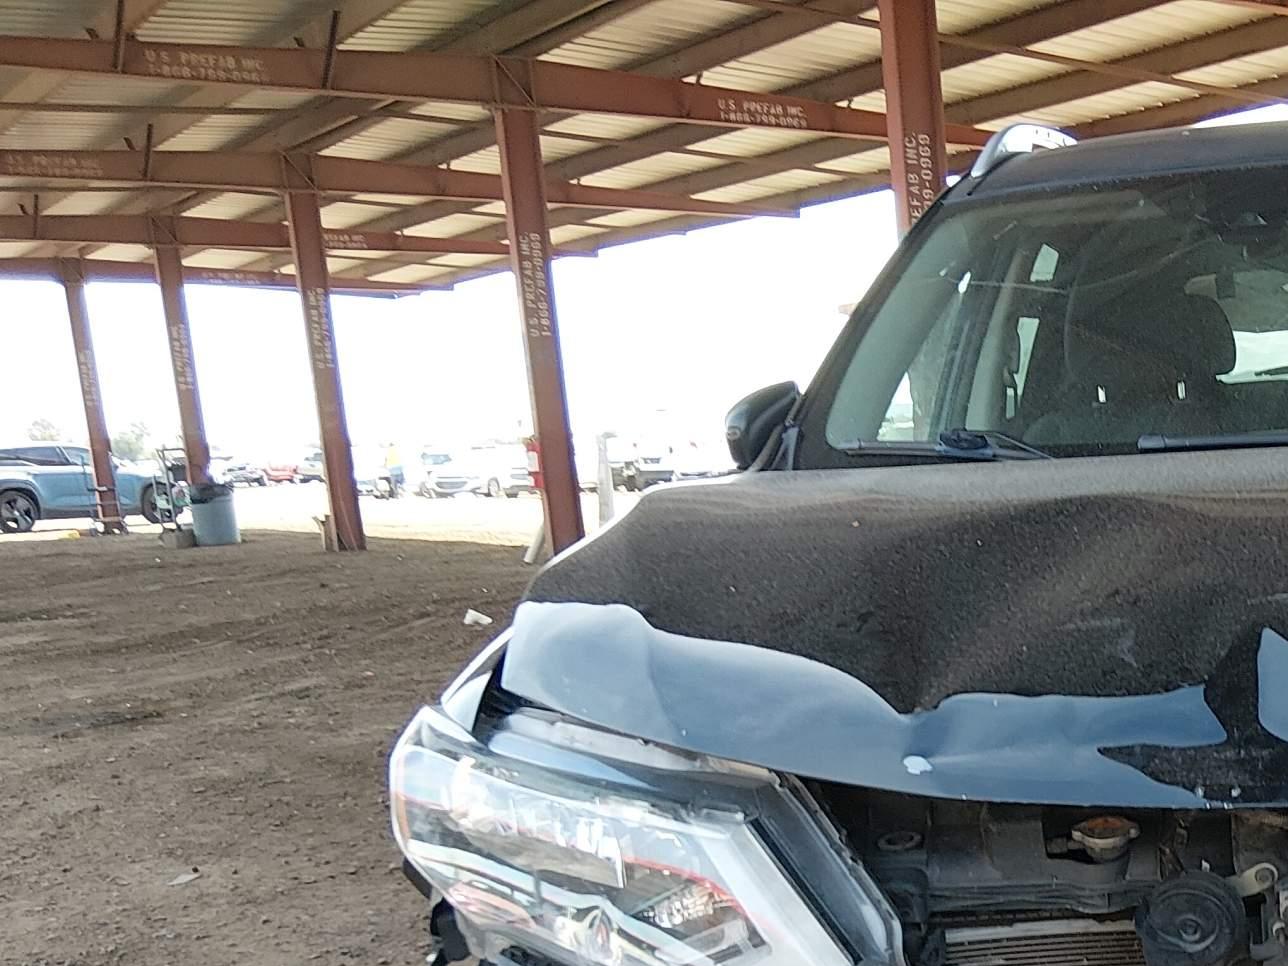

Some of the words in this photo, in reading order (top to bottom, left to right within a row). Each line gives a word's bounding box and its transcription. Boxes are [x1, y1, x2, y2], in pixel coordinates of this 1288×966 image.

[743, 100, 783, 116] PREFAB
[904, 132, 918, 165] INC.
[521, 260, 538, 309] PREFAB
